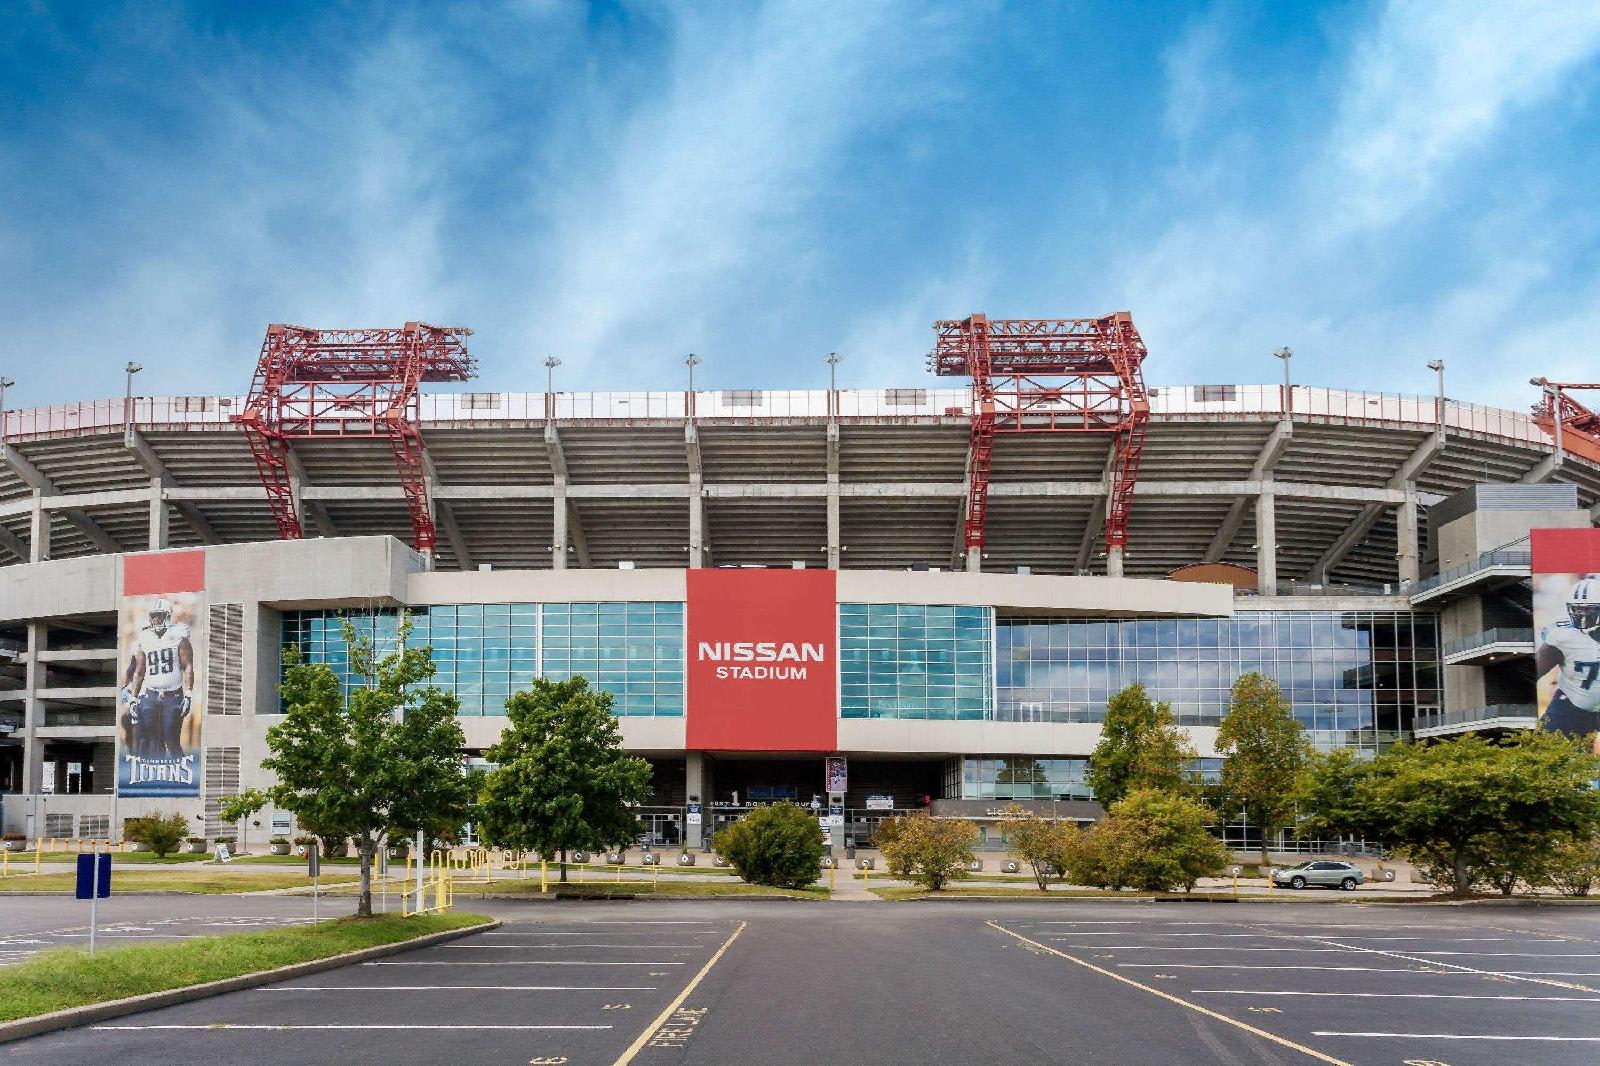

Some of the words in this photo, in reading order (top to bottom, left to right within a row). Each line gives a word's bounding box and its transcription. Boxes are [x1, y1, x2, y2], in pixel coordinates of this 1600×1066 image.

[148, 648, 173, 675] 99
[698, 642, 824, 661] NISSAN
[715, 666, 807, 679] STADIUM
[125, 754, 194, 784] TITANS
